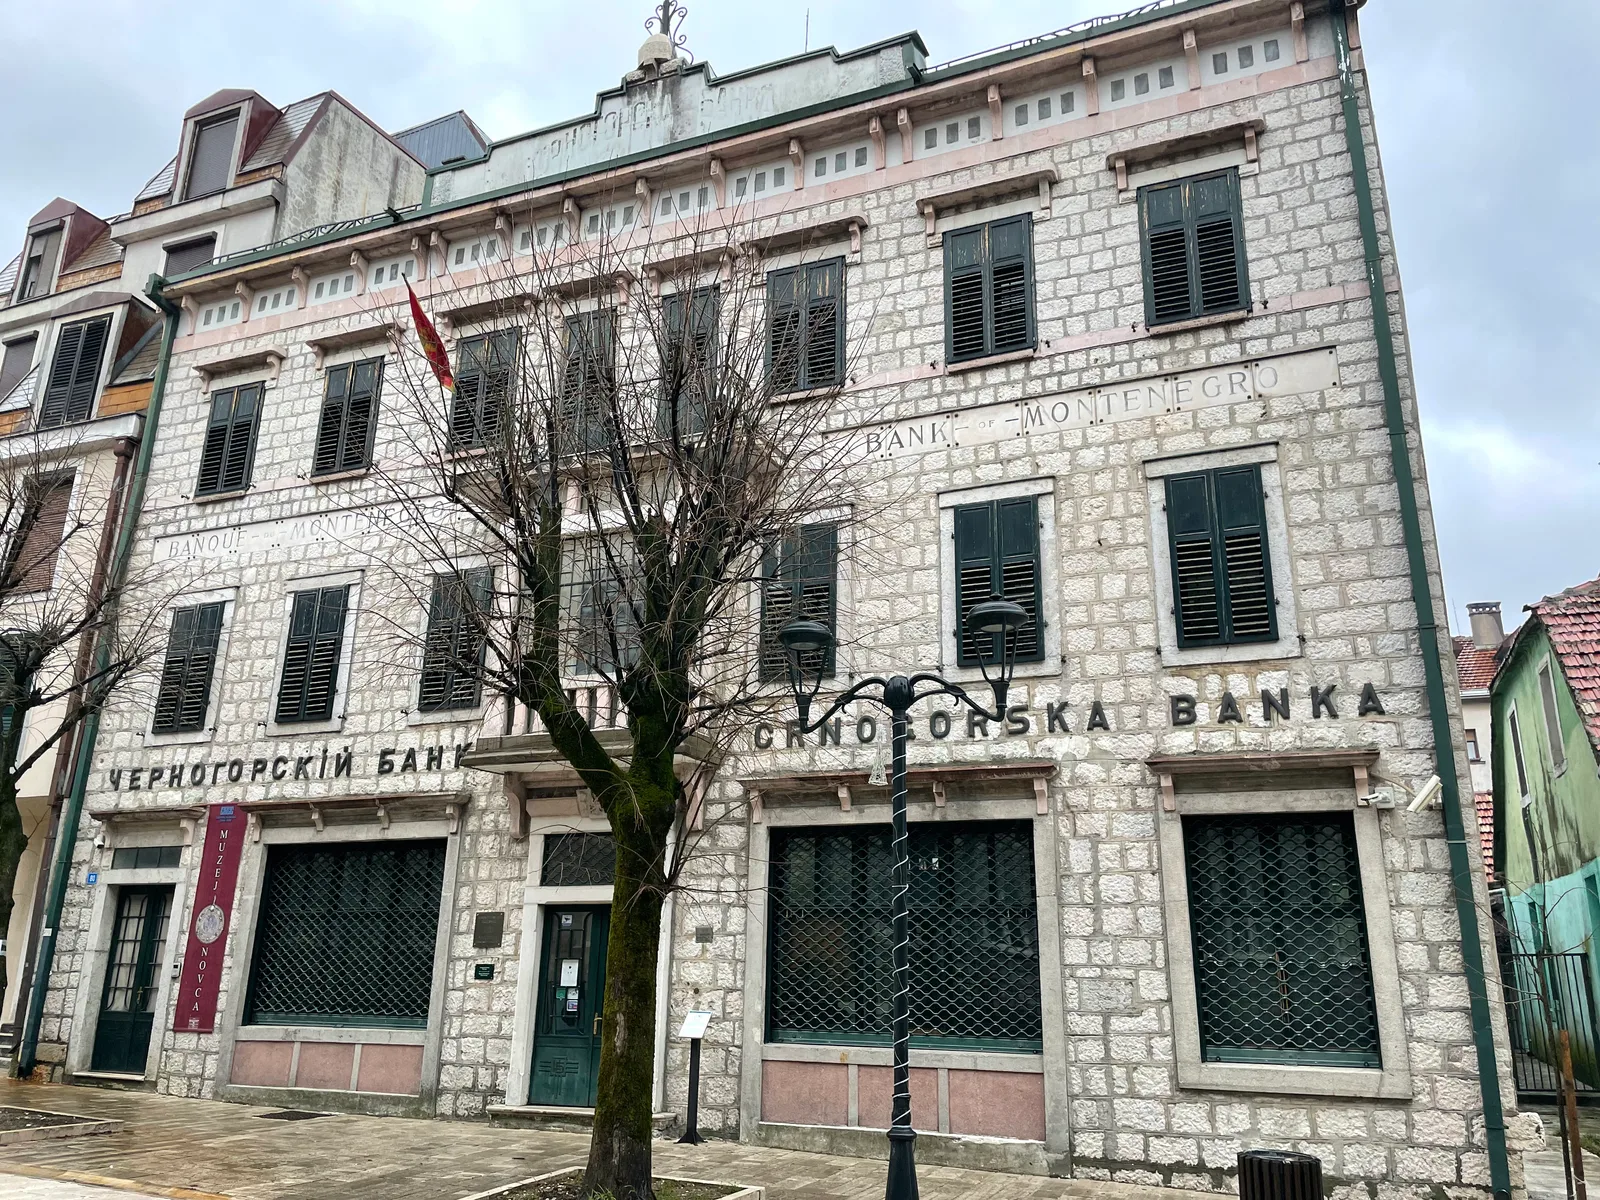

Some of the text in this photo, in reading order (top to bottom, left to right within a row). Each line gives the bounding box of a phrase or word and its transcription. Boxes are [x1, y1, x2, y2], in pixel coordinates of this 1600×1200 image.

[866, 366, 1279, 454] BANK OF MONTENEGRO
[168, 529, 248, 558] BANQUE
[1170, 682, 1386, 727] BANKA
[213, 829, 229, 892] MUZEJ
[192, 947, 209, 1012] NOVCA
